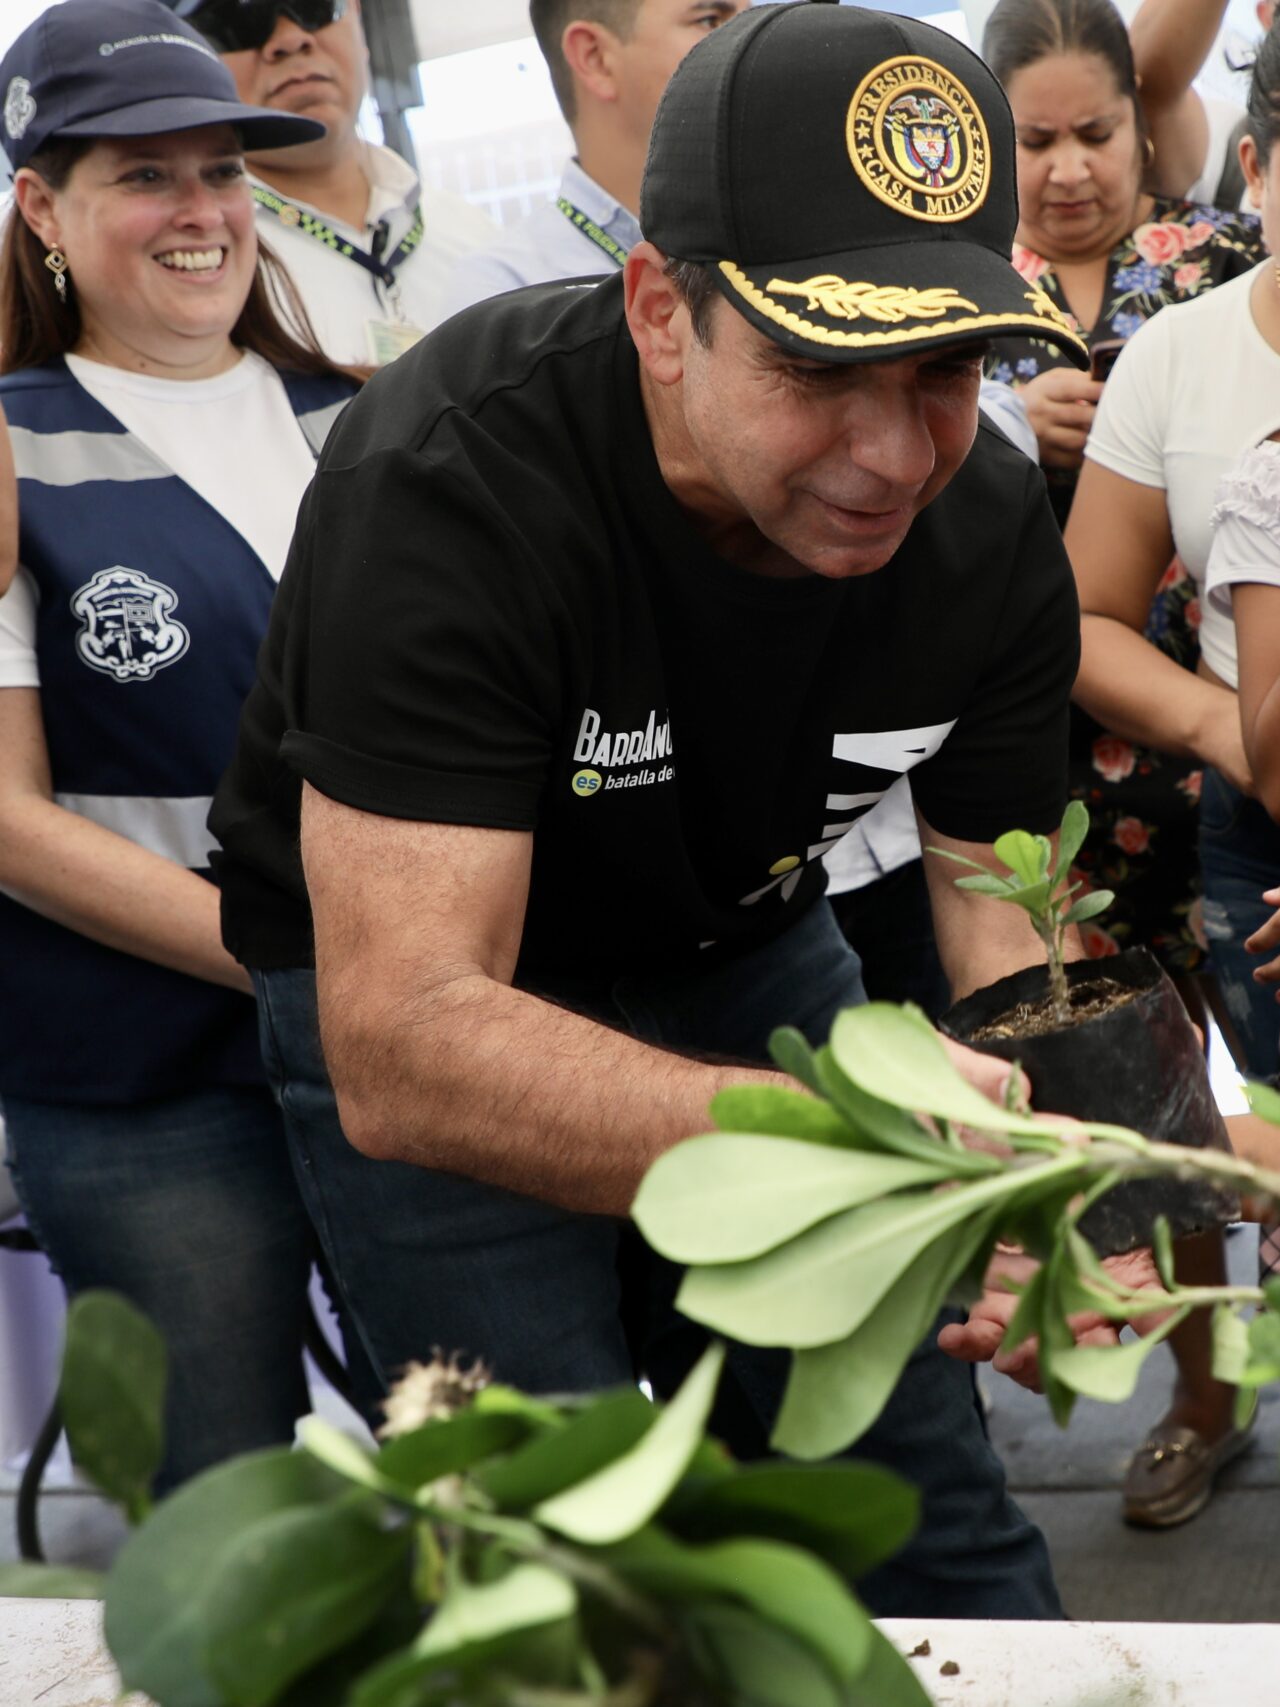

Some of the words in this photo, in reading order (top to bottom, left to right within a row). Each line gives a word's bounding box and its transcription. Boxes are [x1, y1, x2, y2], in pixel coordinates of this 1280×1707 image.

[855, 65, 974, 125] PRESIDENCIA
[866, 159, 914, 209] CASA
[925, 159, 985, 215] MILITAR
[575, 775, 599, 790] es
[604, 769, 656, 790] batalla
[657, 765, 673, 782] de
